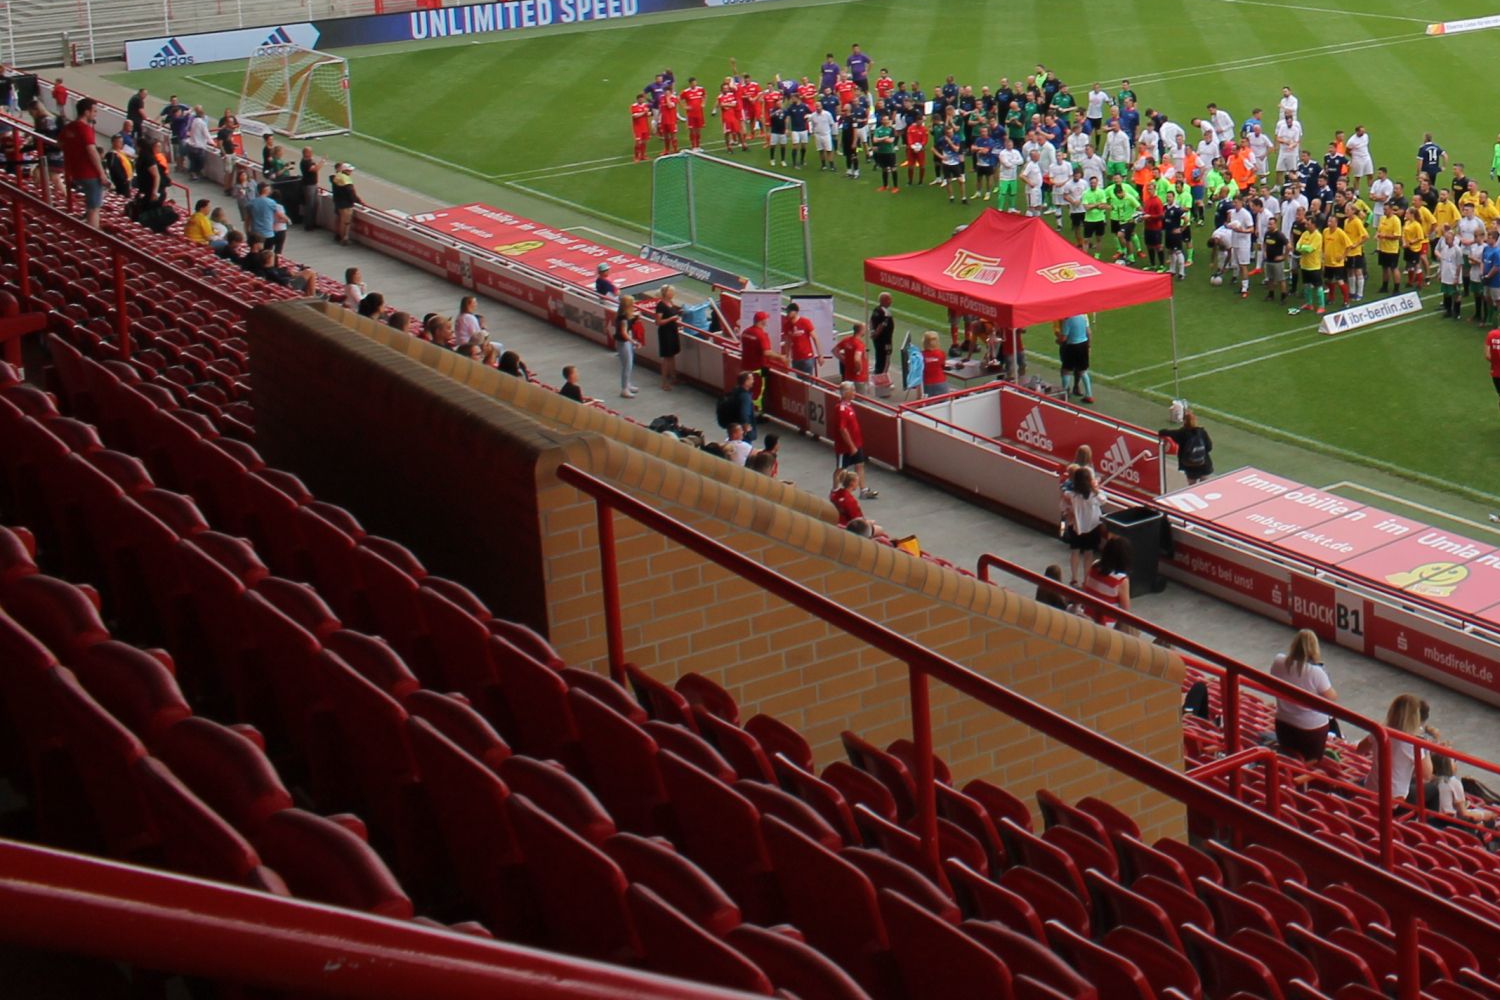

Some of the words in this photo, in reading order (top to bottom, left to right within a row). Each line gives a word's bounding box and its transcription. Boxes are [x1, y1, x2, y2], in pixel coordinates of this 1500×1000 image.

[149, 53, 194, 70] adidas
[1428, 149, 1437, 161] 14
[879, 271, 910, 290] STADION
[911, 278, 922, 293] AN
[937, 287, 959, 306] ALTEN
[1349, 298, 1414, 326] ibr-berlin.de
[808, 400, 826, 425] B2
[1016, 428, 1053, 452] adidas
[1100, 459, 1141, 484] adidas
[1235, 473, 1368, 522] Immobilien
[1373, 515, 1411, 536] im
[1246, 513, 1354, 554] mbsdirekt.de
[1293, 596, 1335, 627] BLOCK
[1336, 603, 1363, 637] B1
[1423, 645, 1494, 684] mbsdirekt.de
